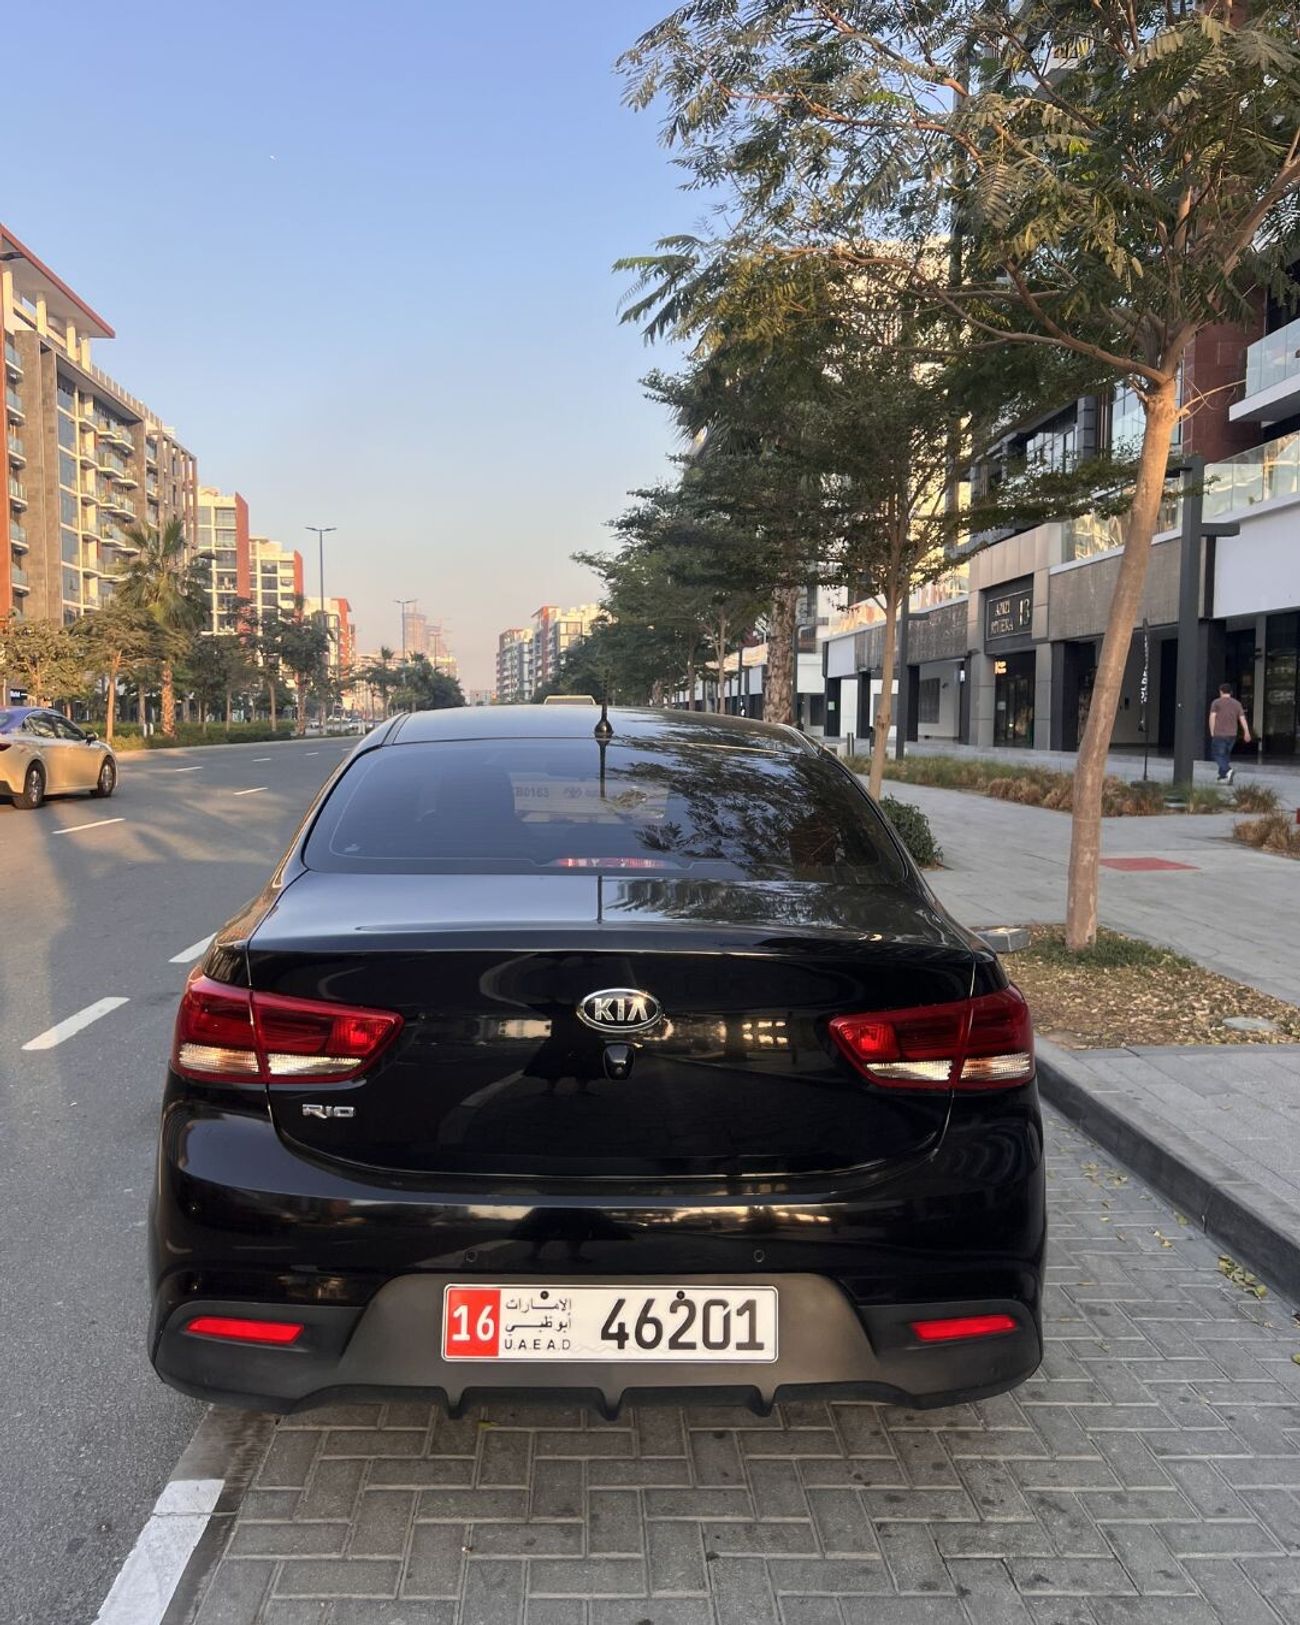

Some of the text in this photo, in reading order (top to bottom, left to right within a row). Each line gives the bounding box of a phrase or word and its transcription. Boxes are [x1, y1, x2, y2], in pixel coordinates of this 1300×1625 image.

[594, 997, 648, 1021] KIA
[302, 1104, 355, 1119] RIO
[452, 1304, 495, 1342] 16
[600, 1297, 765, 1351] 46201
